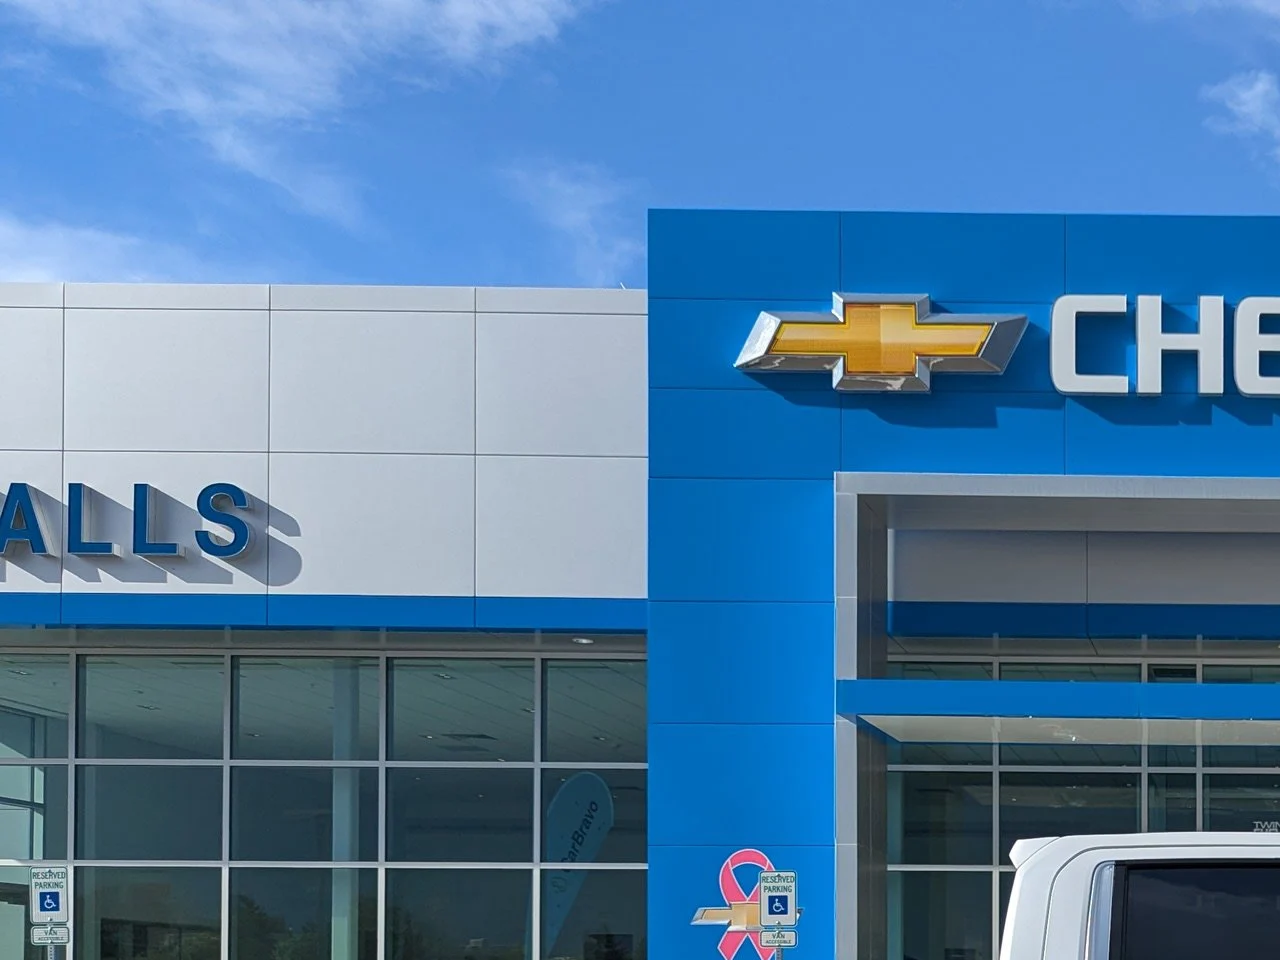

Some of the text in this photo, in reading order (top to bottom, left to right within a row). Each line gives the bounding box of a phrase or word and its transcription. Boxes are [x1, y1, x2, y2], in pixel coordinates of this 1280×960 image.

[0, 482, 250, 558] ALLS
[32, 871, 66, 880] RESERVED
[761, 875, 795, 884] RESERVED
[34, 881, 64, 889] PARKING
[763, 885, 793, 893] PARKING
